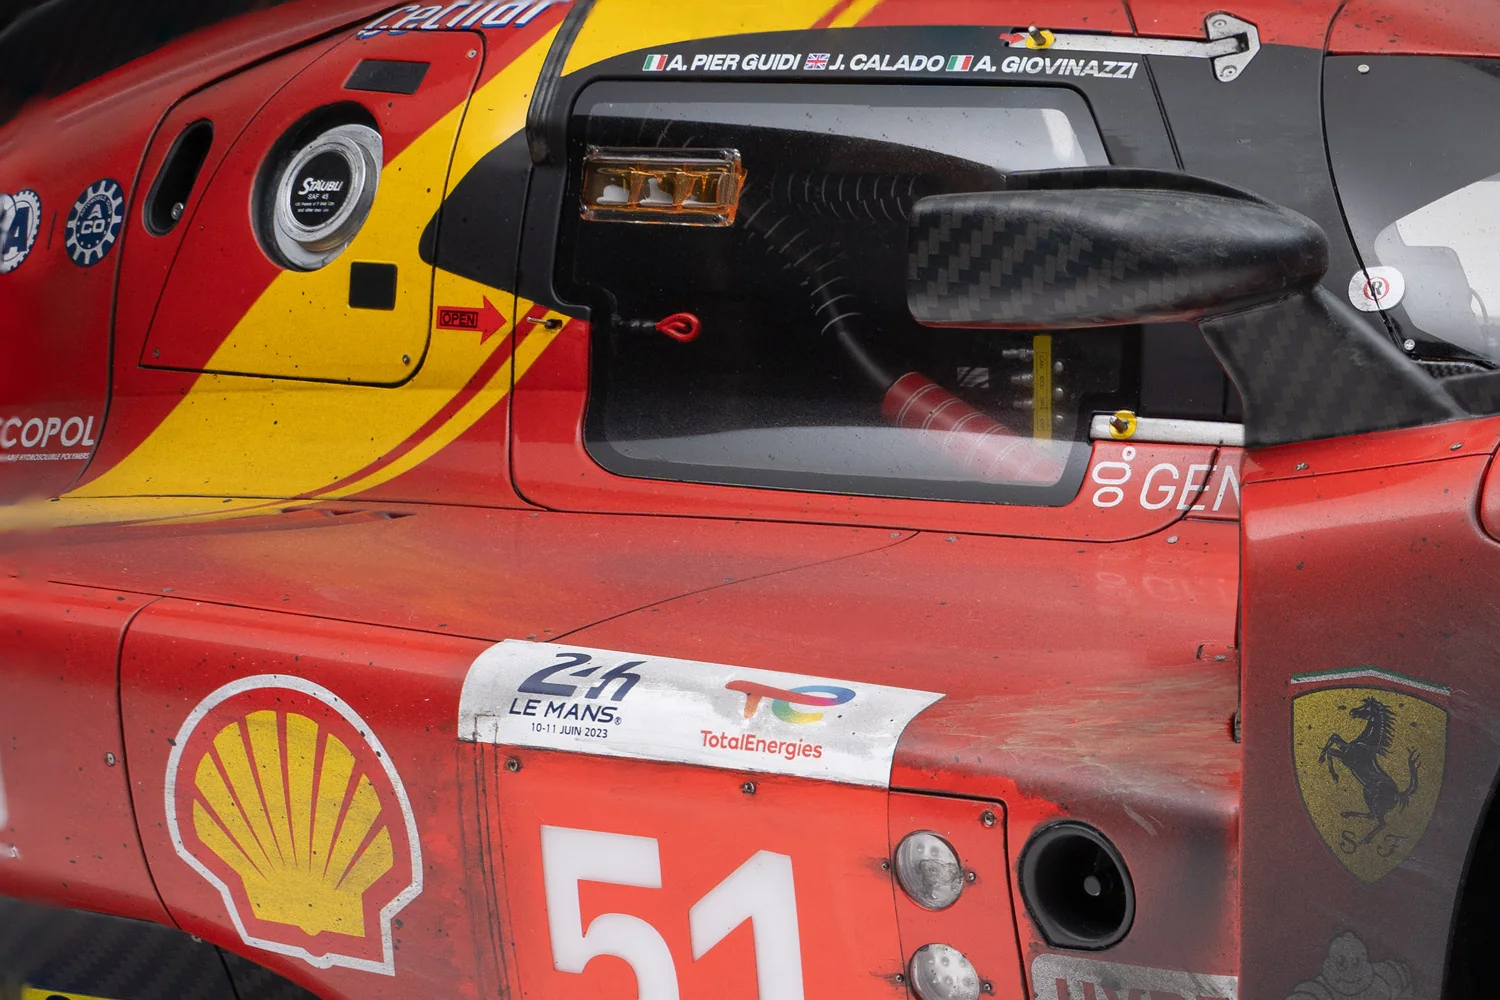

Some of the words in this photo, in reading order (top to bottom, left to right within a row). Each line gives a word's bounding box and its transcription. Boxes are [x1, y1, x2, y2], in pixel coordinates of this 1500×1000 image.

[667, 55, 687, 71] A.
[690, 54, 739, 71] PIER
[742, 54, 802, 71] GUIDI
[829, 54, 845, 70] J.
[849, 54, 944, 72] CALADO
[973, 56, 997, 72] A.
[1001, 56, 1138, 79] GIOVINAZZI
[442, 311, 475, 326] OPEN
[508, 698, 541, 717] LE
[531, 722, 556, 734] 10-11
[559, 725, 582, 736] JUIN
[584, 727, 608, 739] 2023
[701, 730, 823, 760] TotalEnergies
